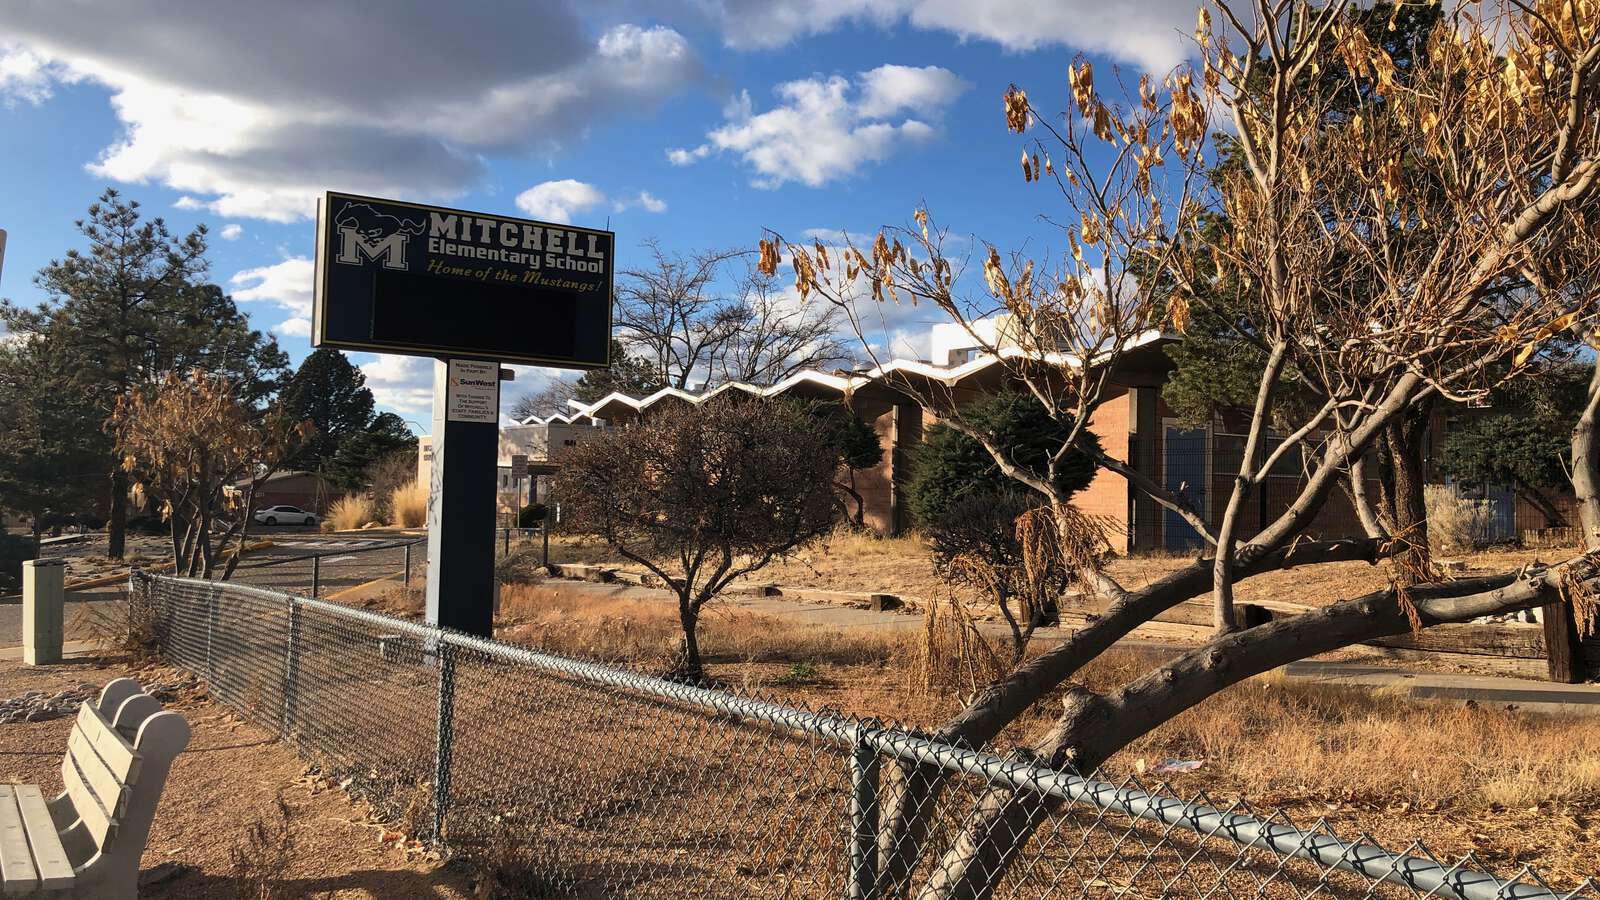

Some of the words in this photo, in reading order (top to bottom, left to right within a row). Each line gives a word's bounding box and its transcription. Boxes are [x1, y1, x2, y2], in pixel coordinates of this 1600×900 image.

[429, 212, 604, 259] MITCHELL
[428, 237, 540, 270] Elementary
[545, 253, 604, 274] School
[427, 259, 472, 278] Home
[475, 267, 491, 280] of
[495, 268, 518, 283] the
[522, 270, 603, 293] Mustangs!
[460, 379, 496, 387] SunWest
